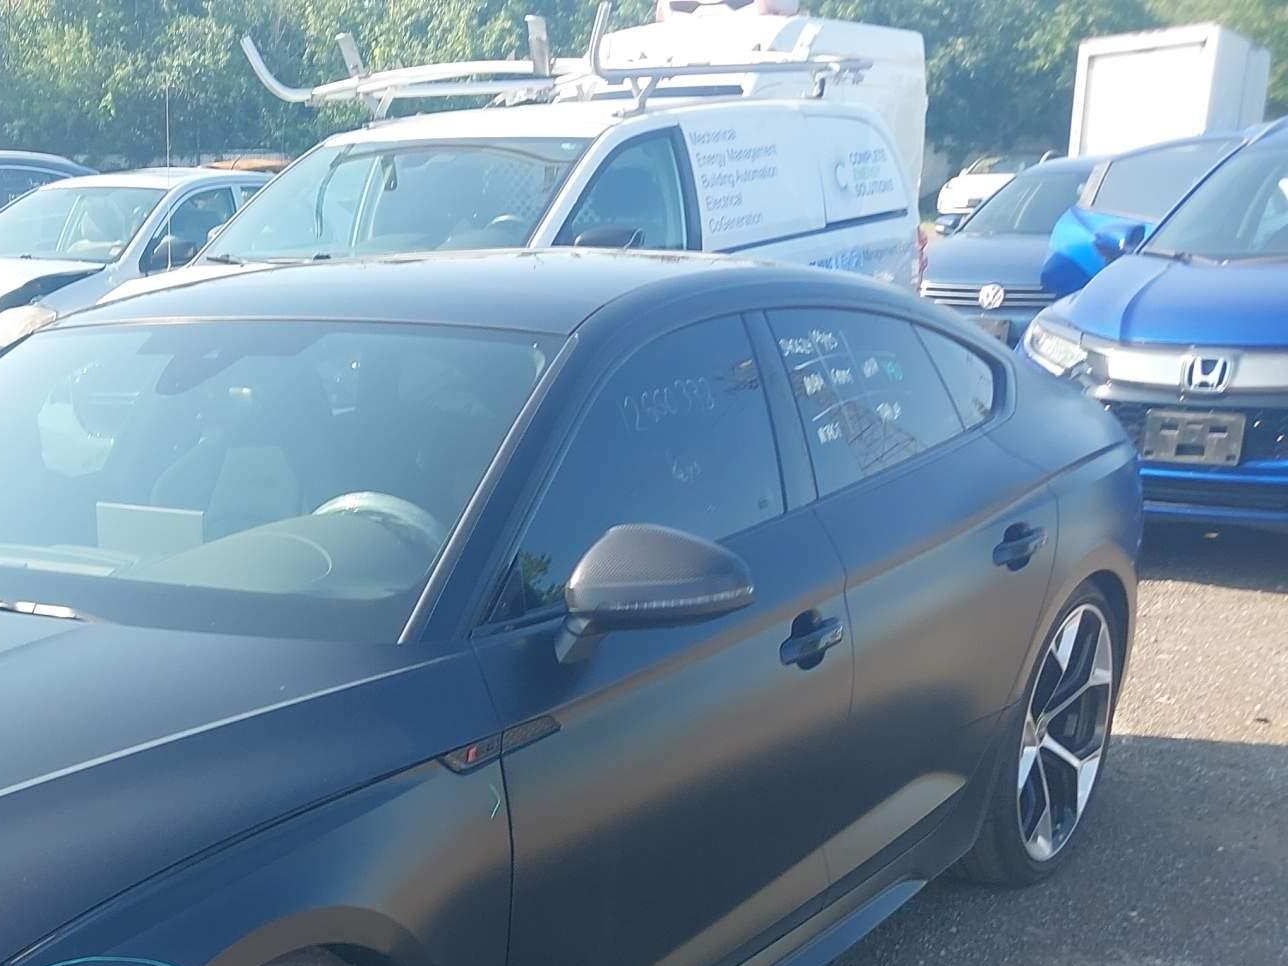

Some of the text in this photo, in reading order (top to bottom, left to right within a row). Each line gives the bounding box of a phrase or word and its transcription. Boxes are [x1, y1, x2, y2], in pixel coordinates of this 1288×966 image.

[696, 144, 777, 168] Energy Management
[701, 166, 778, 189] Building Automation
